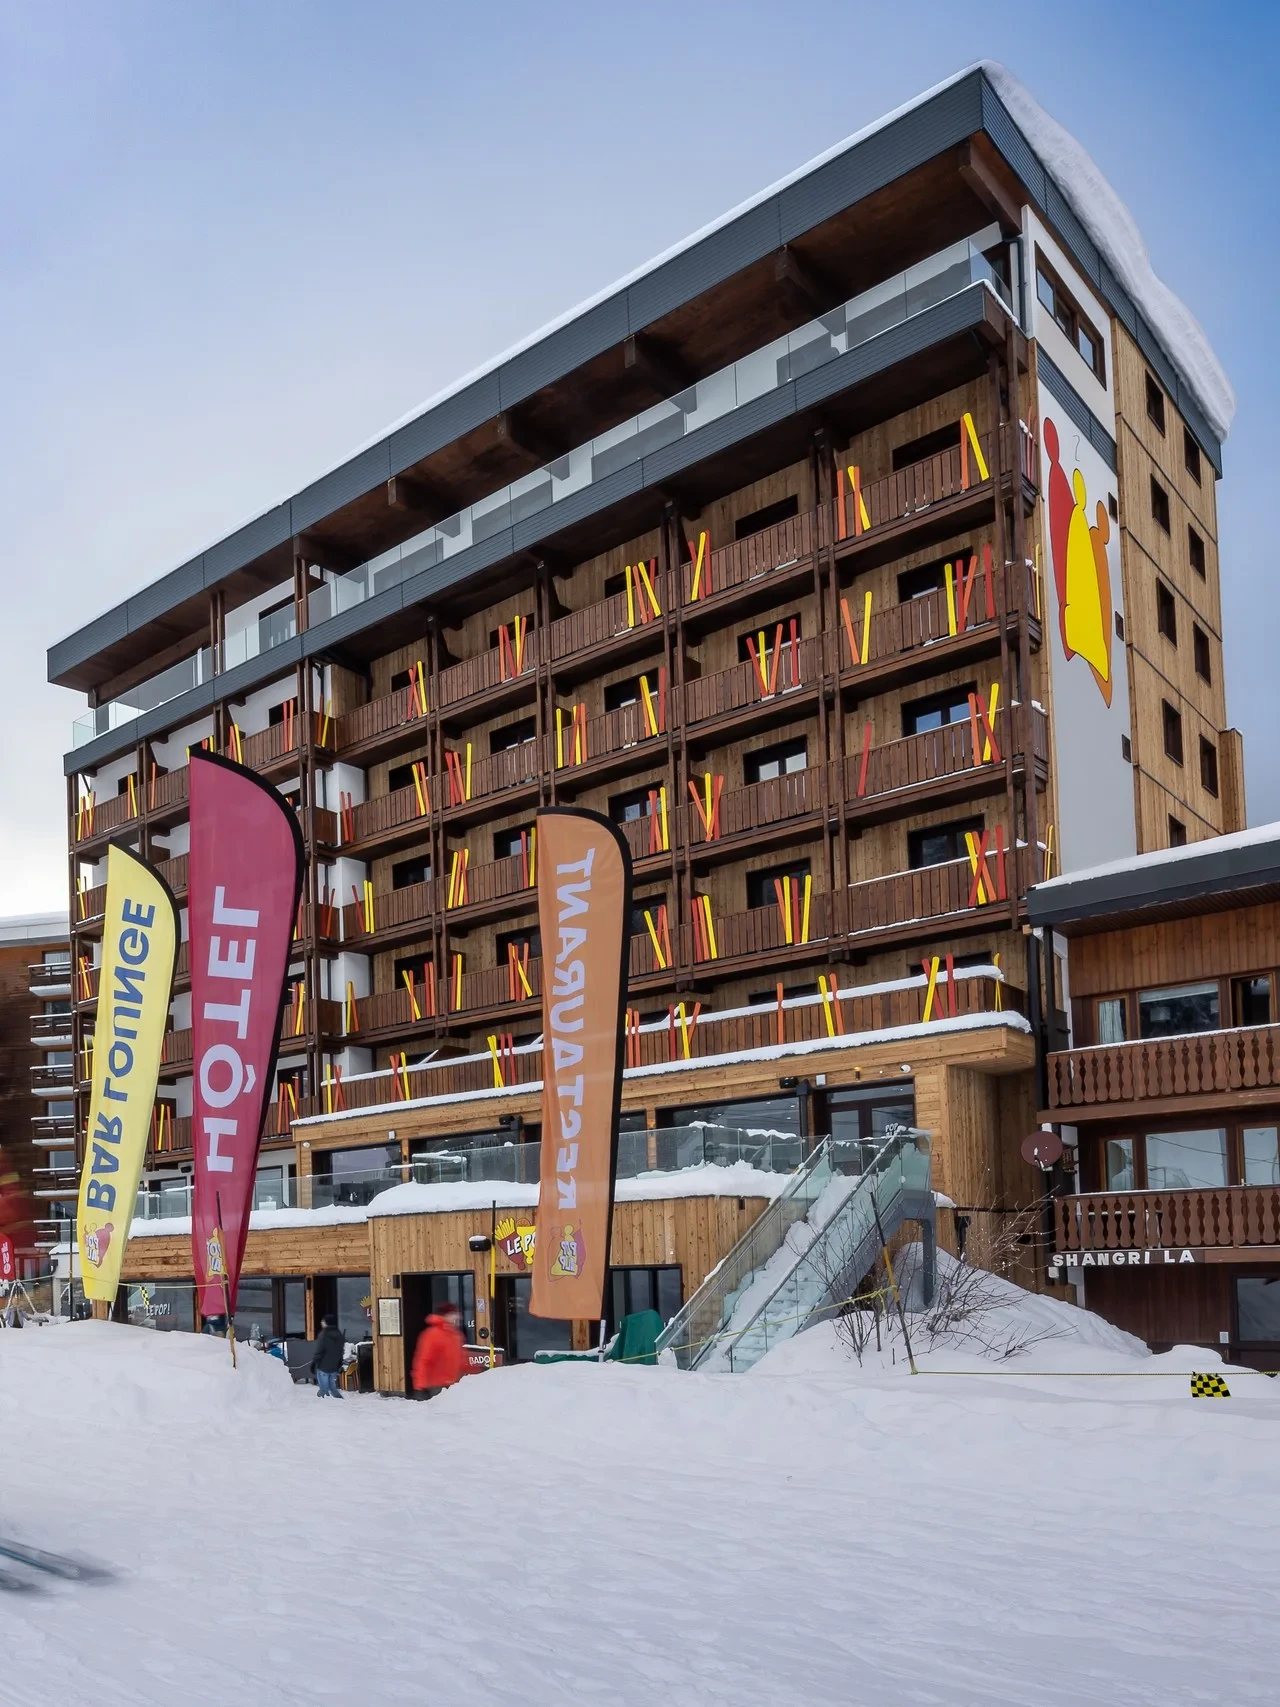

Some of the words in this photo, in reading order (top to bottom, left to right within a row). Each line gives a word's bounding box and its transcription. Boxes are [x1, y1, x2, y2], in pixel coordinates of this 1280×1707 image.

[506, 1236, 522, 1256] LE
[523, 1231, 536, 1252] PO
[1052, 1251, 1150, 1267] SHANGRI
[1163, 1249, 1195, 1264] LA
[468, 1354, 497, 1367] BADOT
